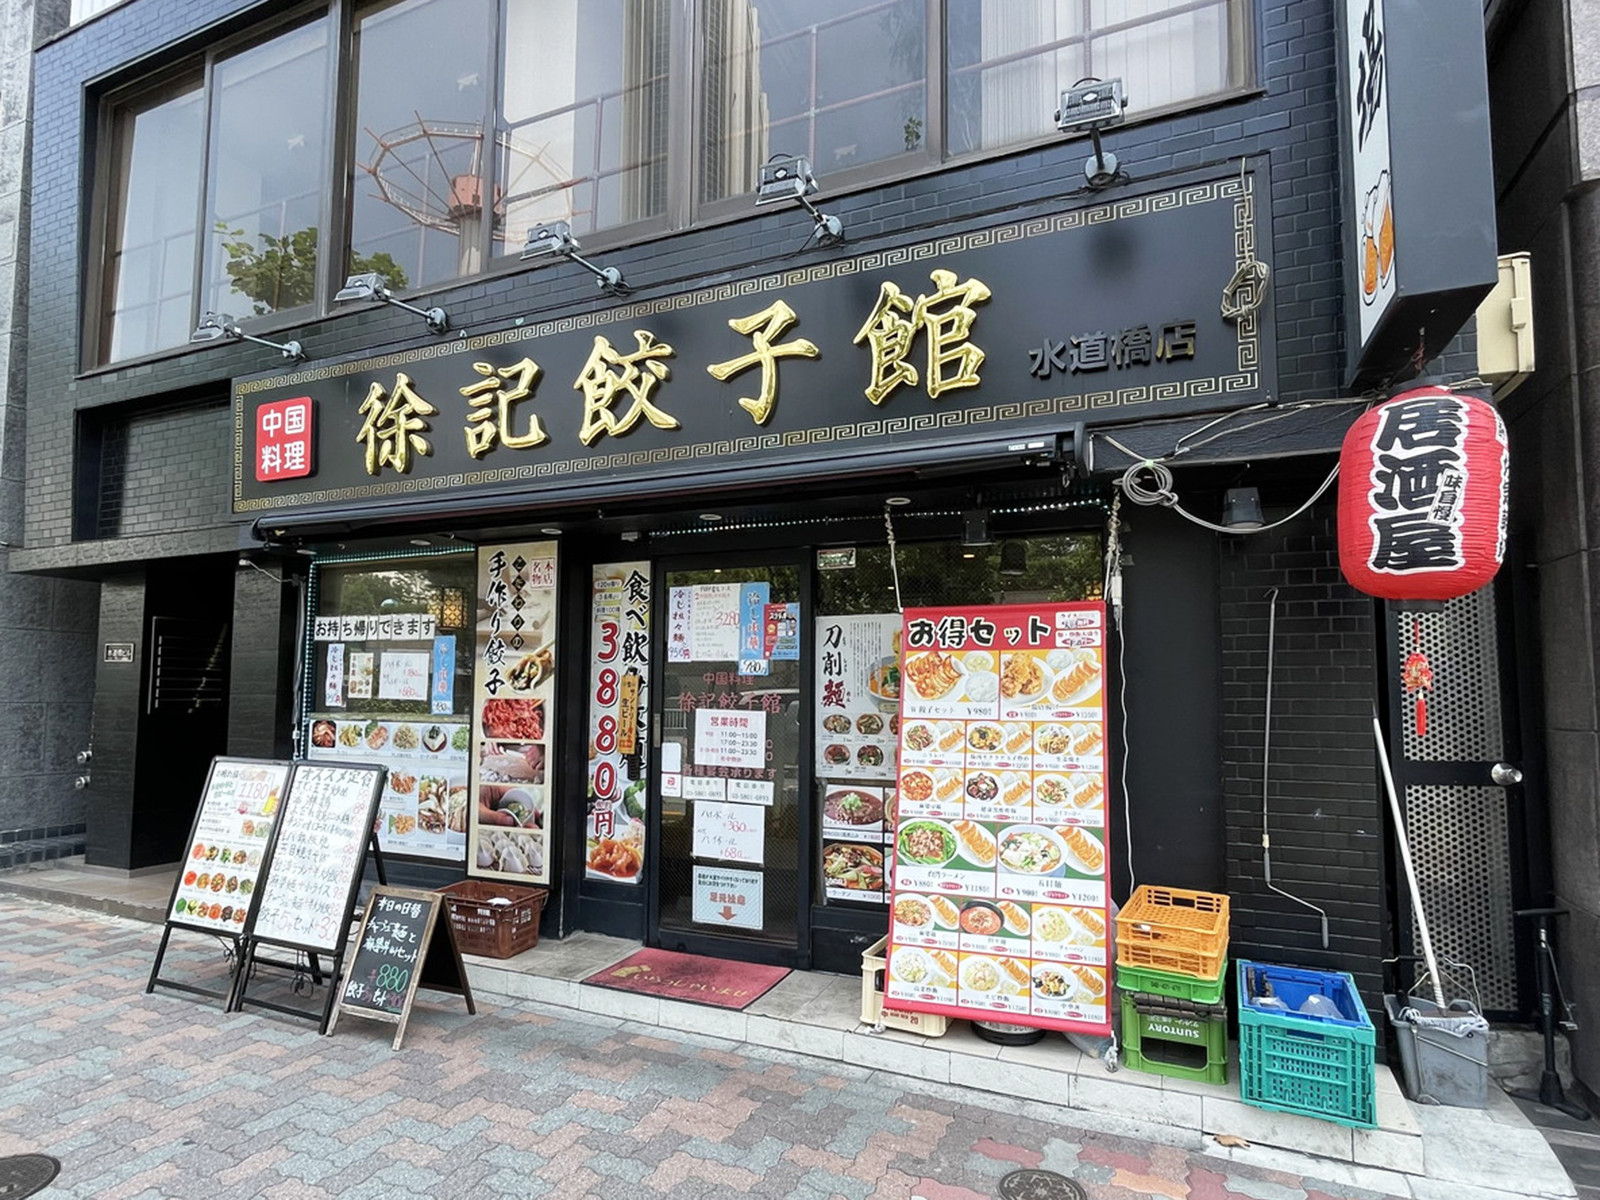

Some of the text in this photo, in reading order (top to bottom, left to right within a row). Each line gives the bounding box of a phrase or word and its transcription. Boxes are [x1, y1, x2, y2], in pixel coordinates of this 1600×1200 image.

[1029, 319, 1198, 379] 水道橋店
[356, 268, 992, 476] 徐記餃子館
[261, 405, 307, 437] 中国
[261, 441, 305, 474] 料理
[1370, 396, 1467, 573] 居酒屋
[1432, 473, 1463, 523] 味自慢
[315, 617, 435, 637] お持ち帰りできます
[484, 549, 507, 695] 手作り餃子
[747, 591, 760, 652] 冷し中華
[908, 616, 1051, 648] お得セット
[622, 569, 650, 769] 食べ飲
[702, 672, 755, 686] 中国料理
[822, 624, 846, 710] 刀削麺
[679, 691, 782, 714] 徐記餃子館
[591, 620, 618, 837] 3880円
[711, 716, 749, 728] 営業時間
[238, 782, 269, 800] 1180
[302, 767, 374, 788] オススメ定食
[378, 896, 422, 919] 本日の日替
[909, 1015, 919, 1025] 20
